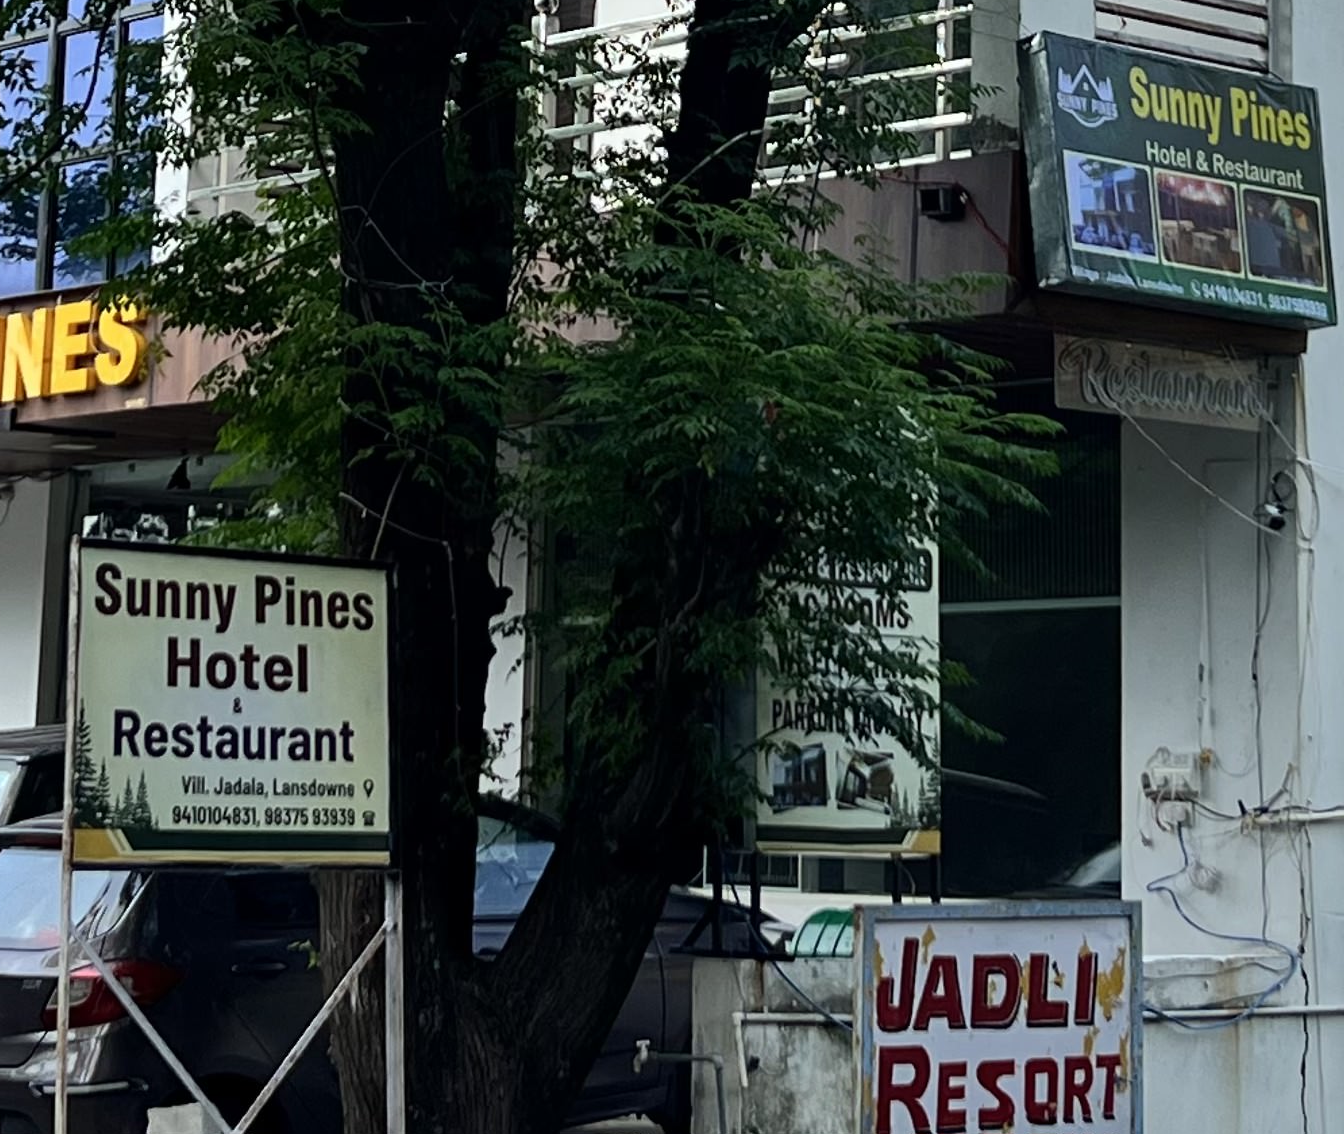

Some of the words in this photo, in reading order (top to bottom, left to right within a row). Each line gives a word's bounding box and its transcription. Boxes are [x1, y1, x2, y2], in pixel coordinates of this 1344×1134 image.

[1128, 65, 1222, 146] Sunny
[1229, 86, 1311, 150] Pines
[1145, 139, 1191, 167] Hotel
[1195, 152, 1209, 172] &
[1212, 152, 1304, 190] Restaurant
[1058, 339, 1274, 418] Restaurant
[94, 562, 237, 634] Sunny
[254, 574, 375, 631] Pines
[166, 635, 309, 693] Hotel
[232, 697, 243, 714] &
[113, 708, 354, 763] Restaurant
[181, 775, 210, 795] Vill.
[214, 776, 269, 798] Jadala,
[272, 777, 355, 798] Lansdowne
[172, 805, 260, 827] 9410104831,
[264, 806, 308, 826] 98375
[875, 936, 1099, 1033] JADLI
[875, 1044, 1122, 1134] RESORT
